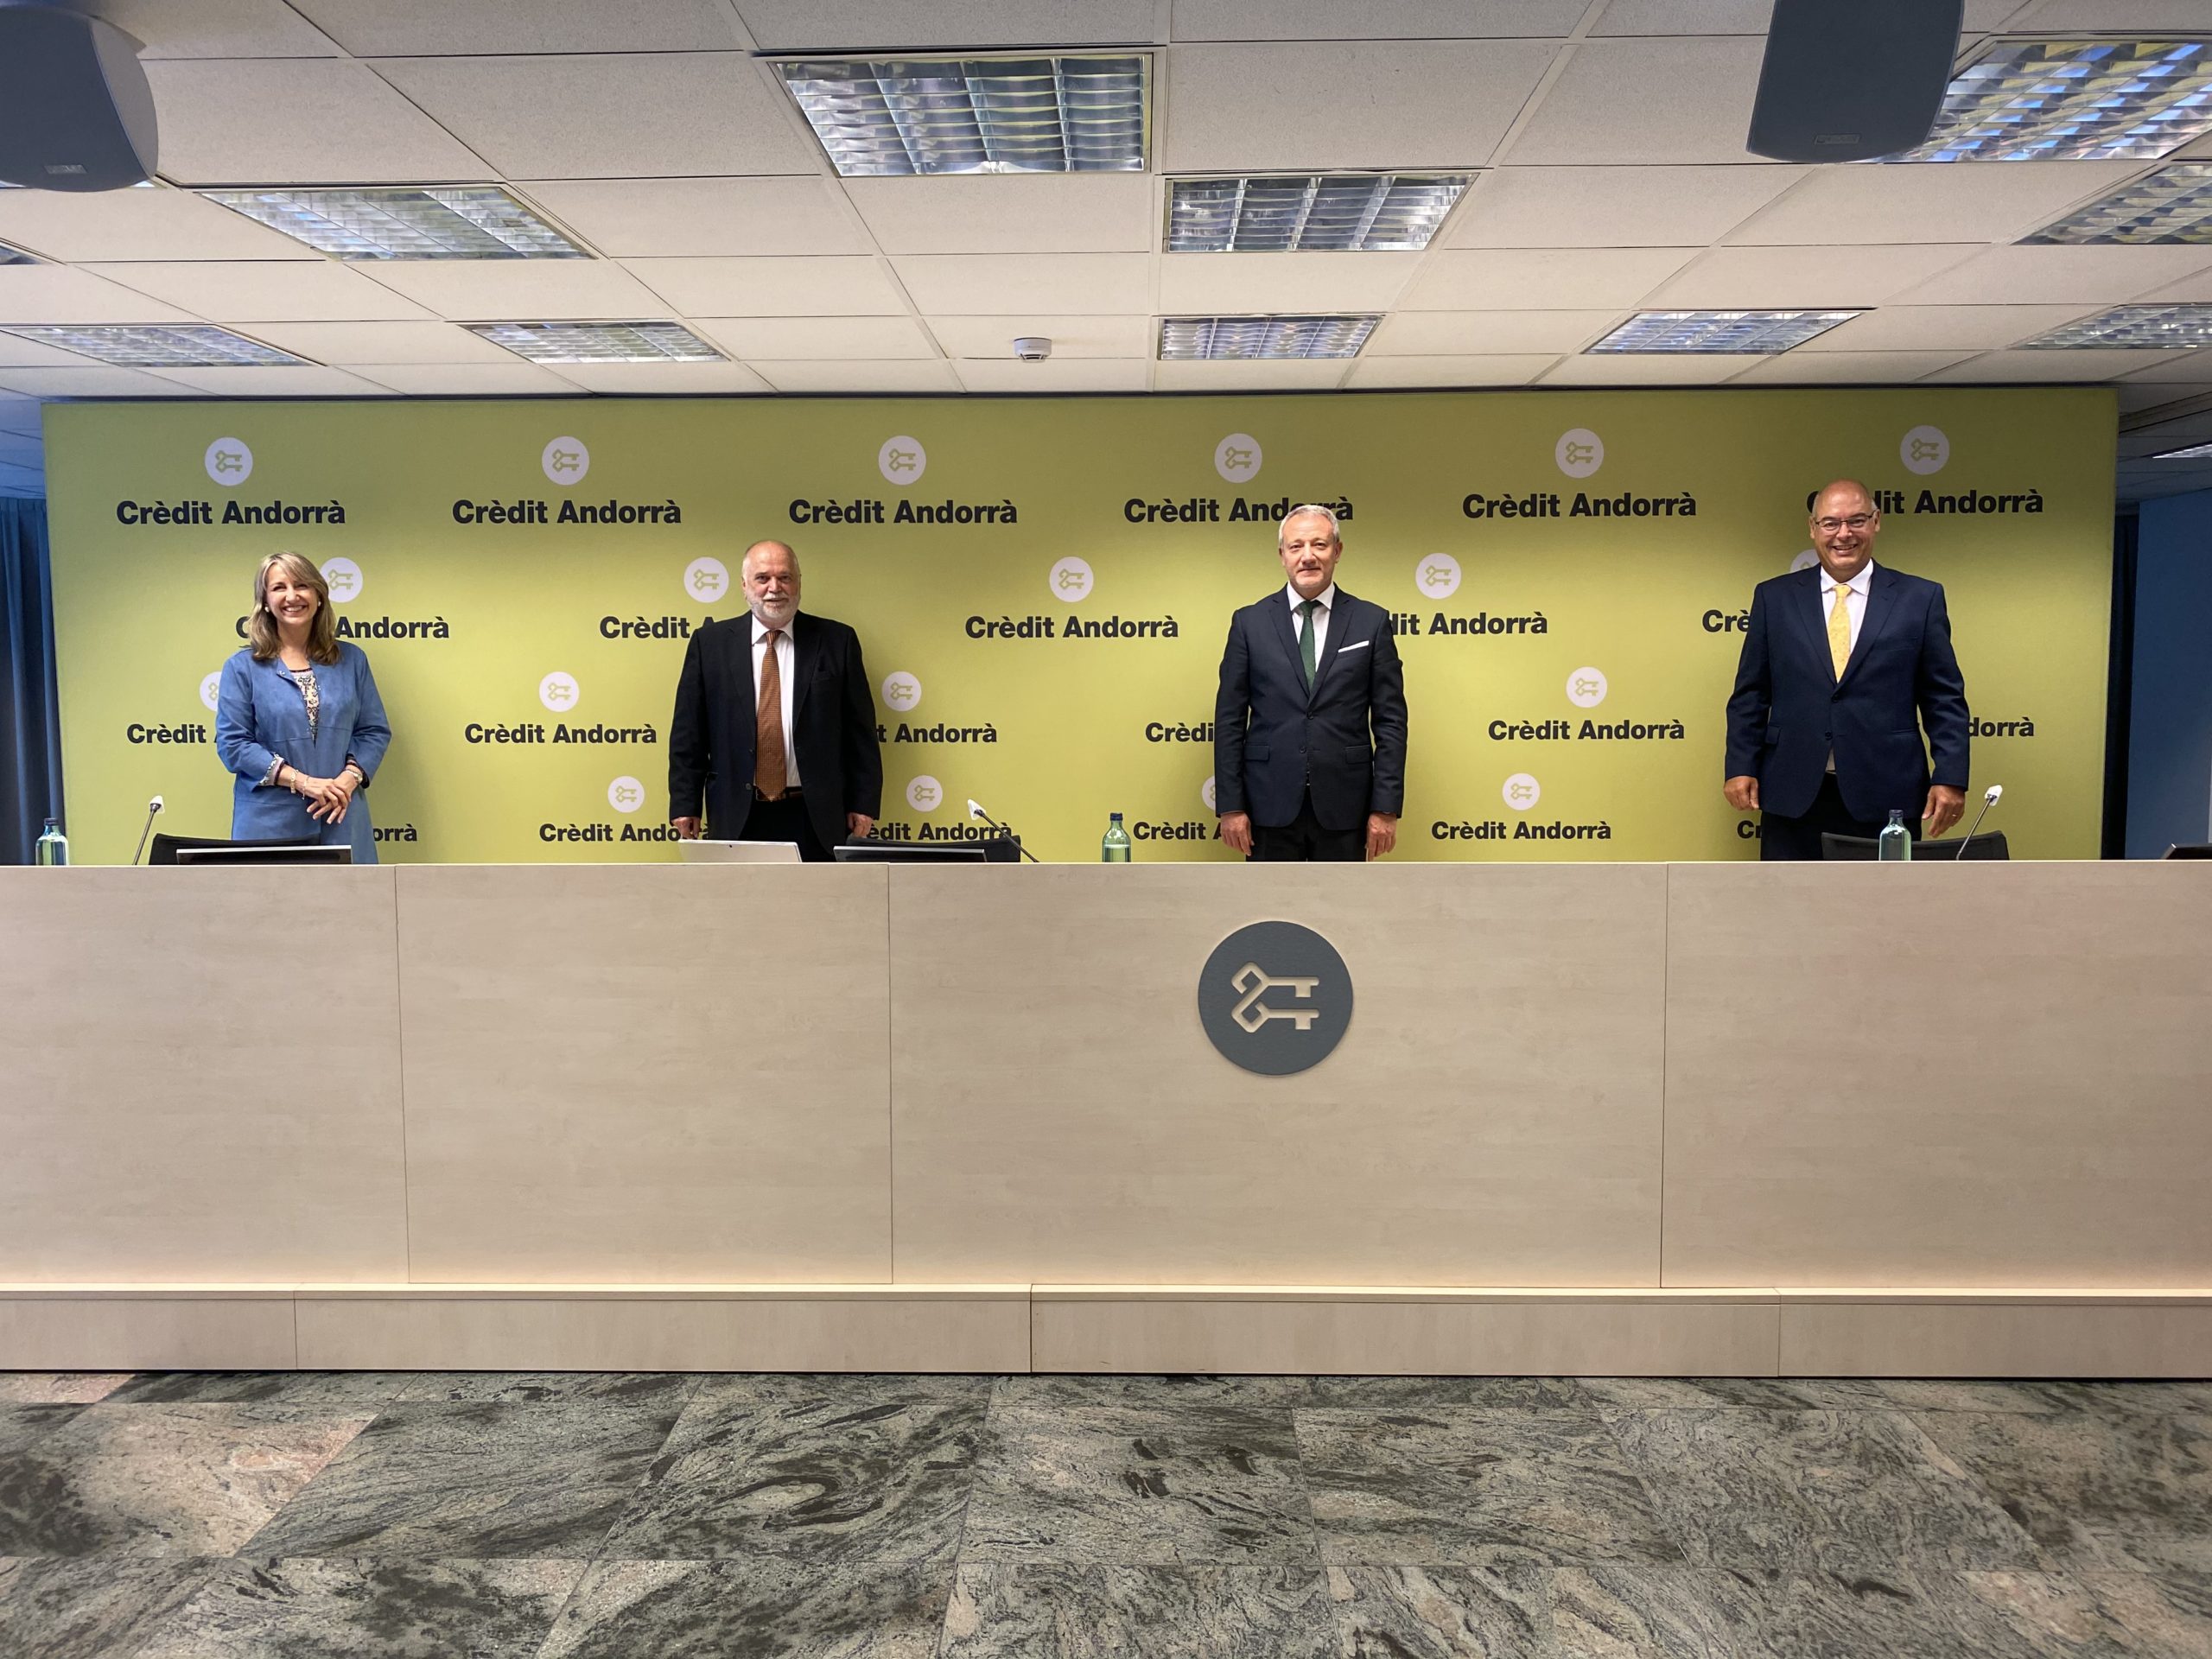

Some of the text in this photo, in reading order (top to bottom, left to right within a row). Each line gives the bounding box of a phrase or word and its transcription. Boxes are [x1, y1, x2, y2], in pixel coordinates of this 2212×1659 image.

[116, 499, 346, 525] Crèdit Andorrà
[452, 499, 682, 524] Crèdit Andorrà
[789, 499, 1018, 524] Crèdit Andorrà
[1124, 498, 1220, 524] Crèdit
[1462, 492, 1697, 518] Crèdit Andorrà
[1914, 488, 2044, 514] Andorrà
[334, 616, 449, 639] Andorrà
[600, 615, 690, 639] Crèdit
[965, 615, 1179, 639] Crèdit Andorrà
[1427, 611, 1548, 635] Andorrà
[1702, 609, 1750, 633] Crè
[126, 723, 207, 744] Crèdit
[464, 723, 658, 744] Crèdit Andorrà
[893, 722, 997, 743] Andorrà
[1145, 721, 1214, 743] Crèdi
[1488, 719, 1685, 741] Crèdit Andorrà
[1967, 716, 2035, 737] dorrà
[539, 823, 613, 842] Crèdit
[867, 822, 912, 841] èdit
[1133, 821, 1207, 841] Crèdit
[1431, 820, 1611, 840] Crèdit Andorrà
